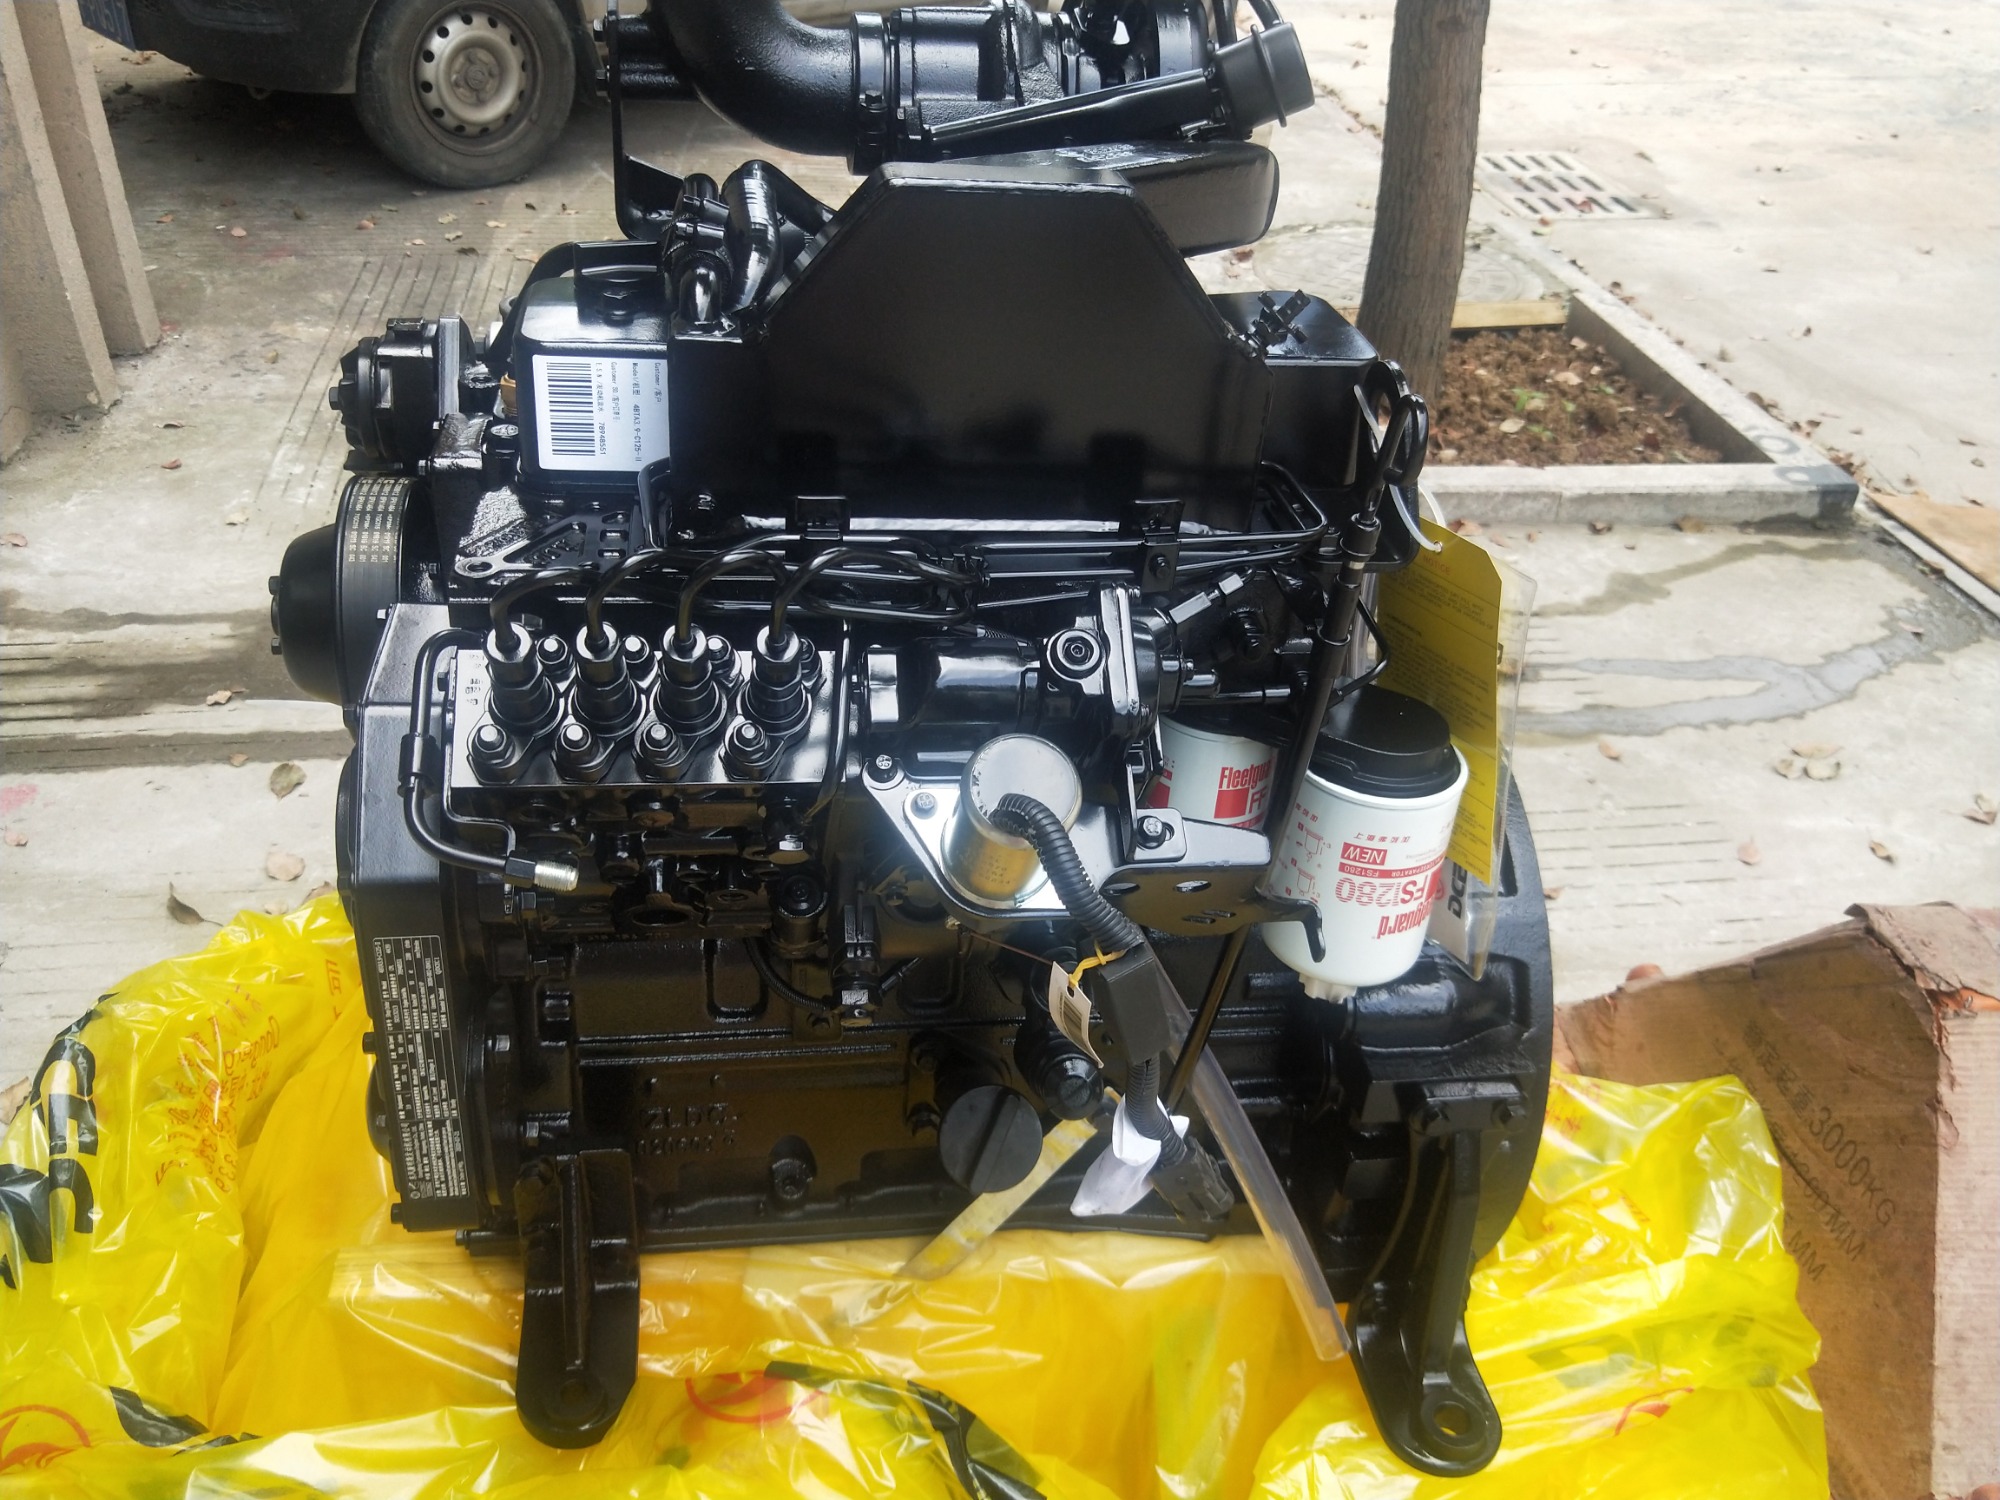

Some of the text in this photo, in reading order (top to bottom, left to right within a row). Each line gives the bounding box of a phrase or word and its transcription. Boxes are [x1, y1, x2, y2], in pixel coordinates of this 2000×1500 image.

[610, 361, 619, 385] Customer
[654, 362, 662, 386] Customer
[598, 421, 607, 456] 78948551
[1344, 846, 1386, 864] NEW
[1344, 866, 1380, 877] FS1280
[1335, 873, 1429, 908] FS1280
